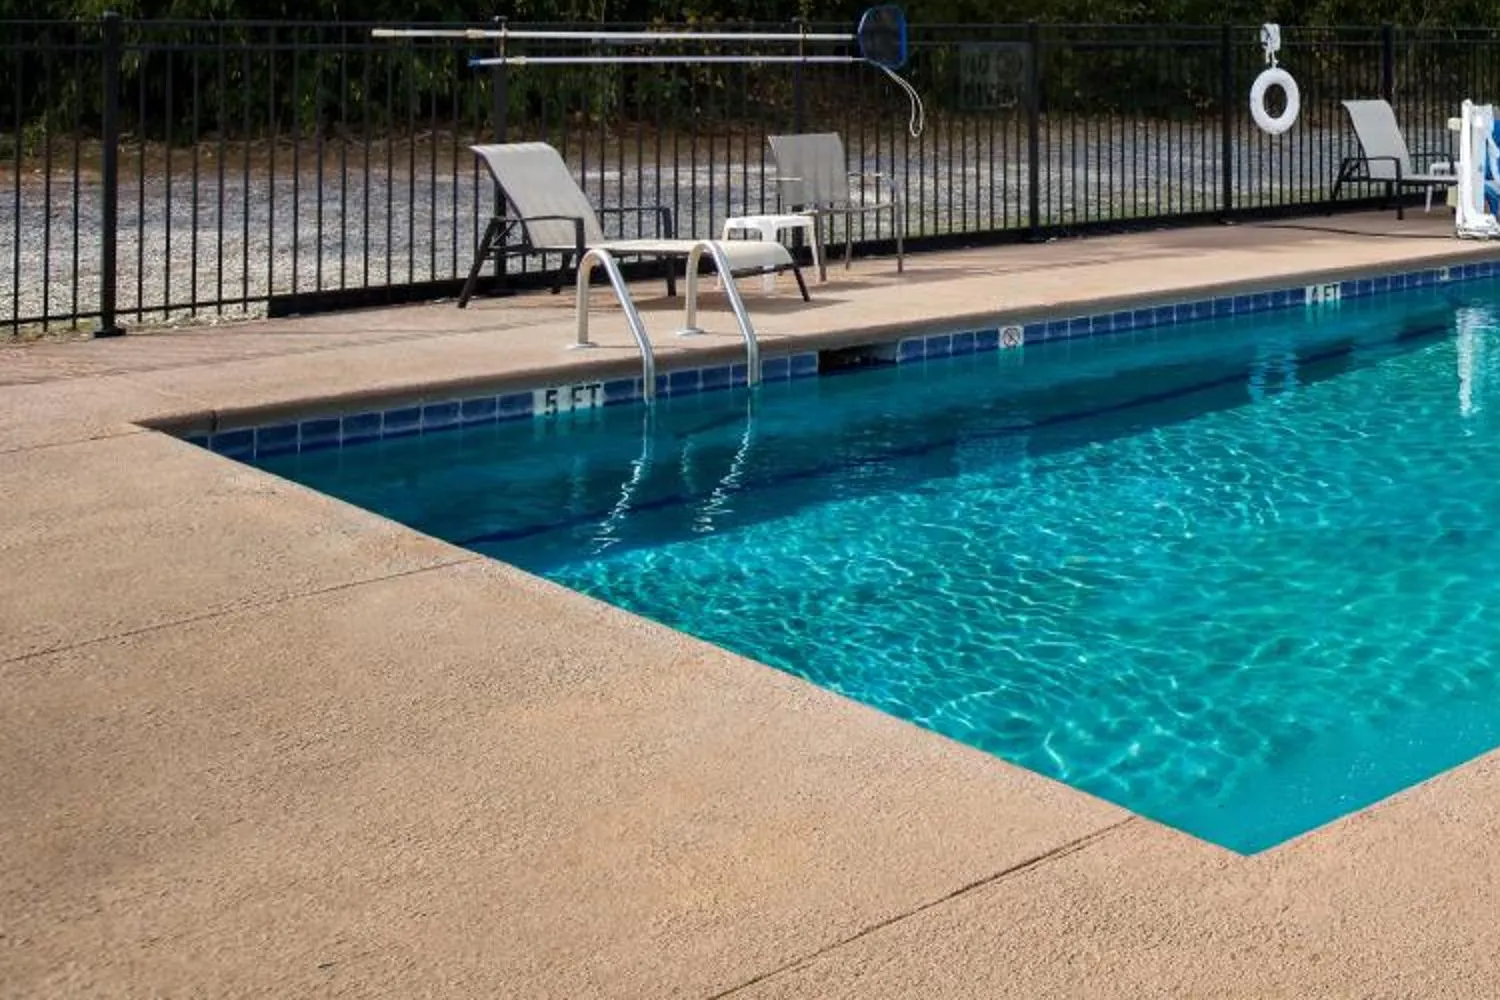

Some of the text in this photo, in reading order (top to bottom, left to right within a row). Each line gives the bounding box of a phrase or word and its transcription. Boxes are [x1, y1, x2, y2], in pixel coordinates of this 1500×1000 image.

[1323, 283, 1339, 304] FT
[545, 383, 602, 417] 5 FT
